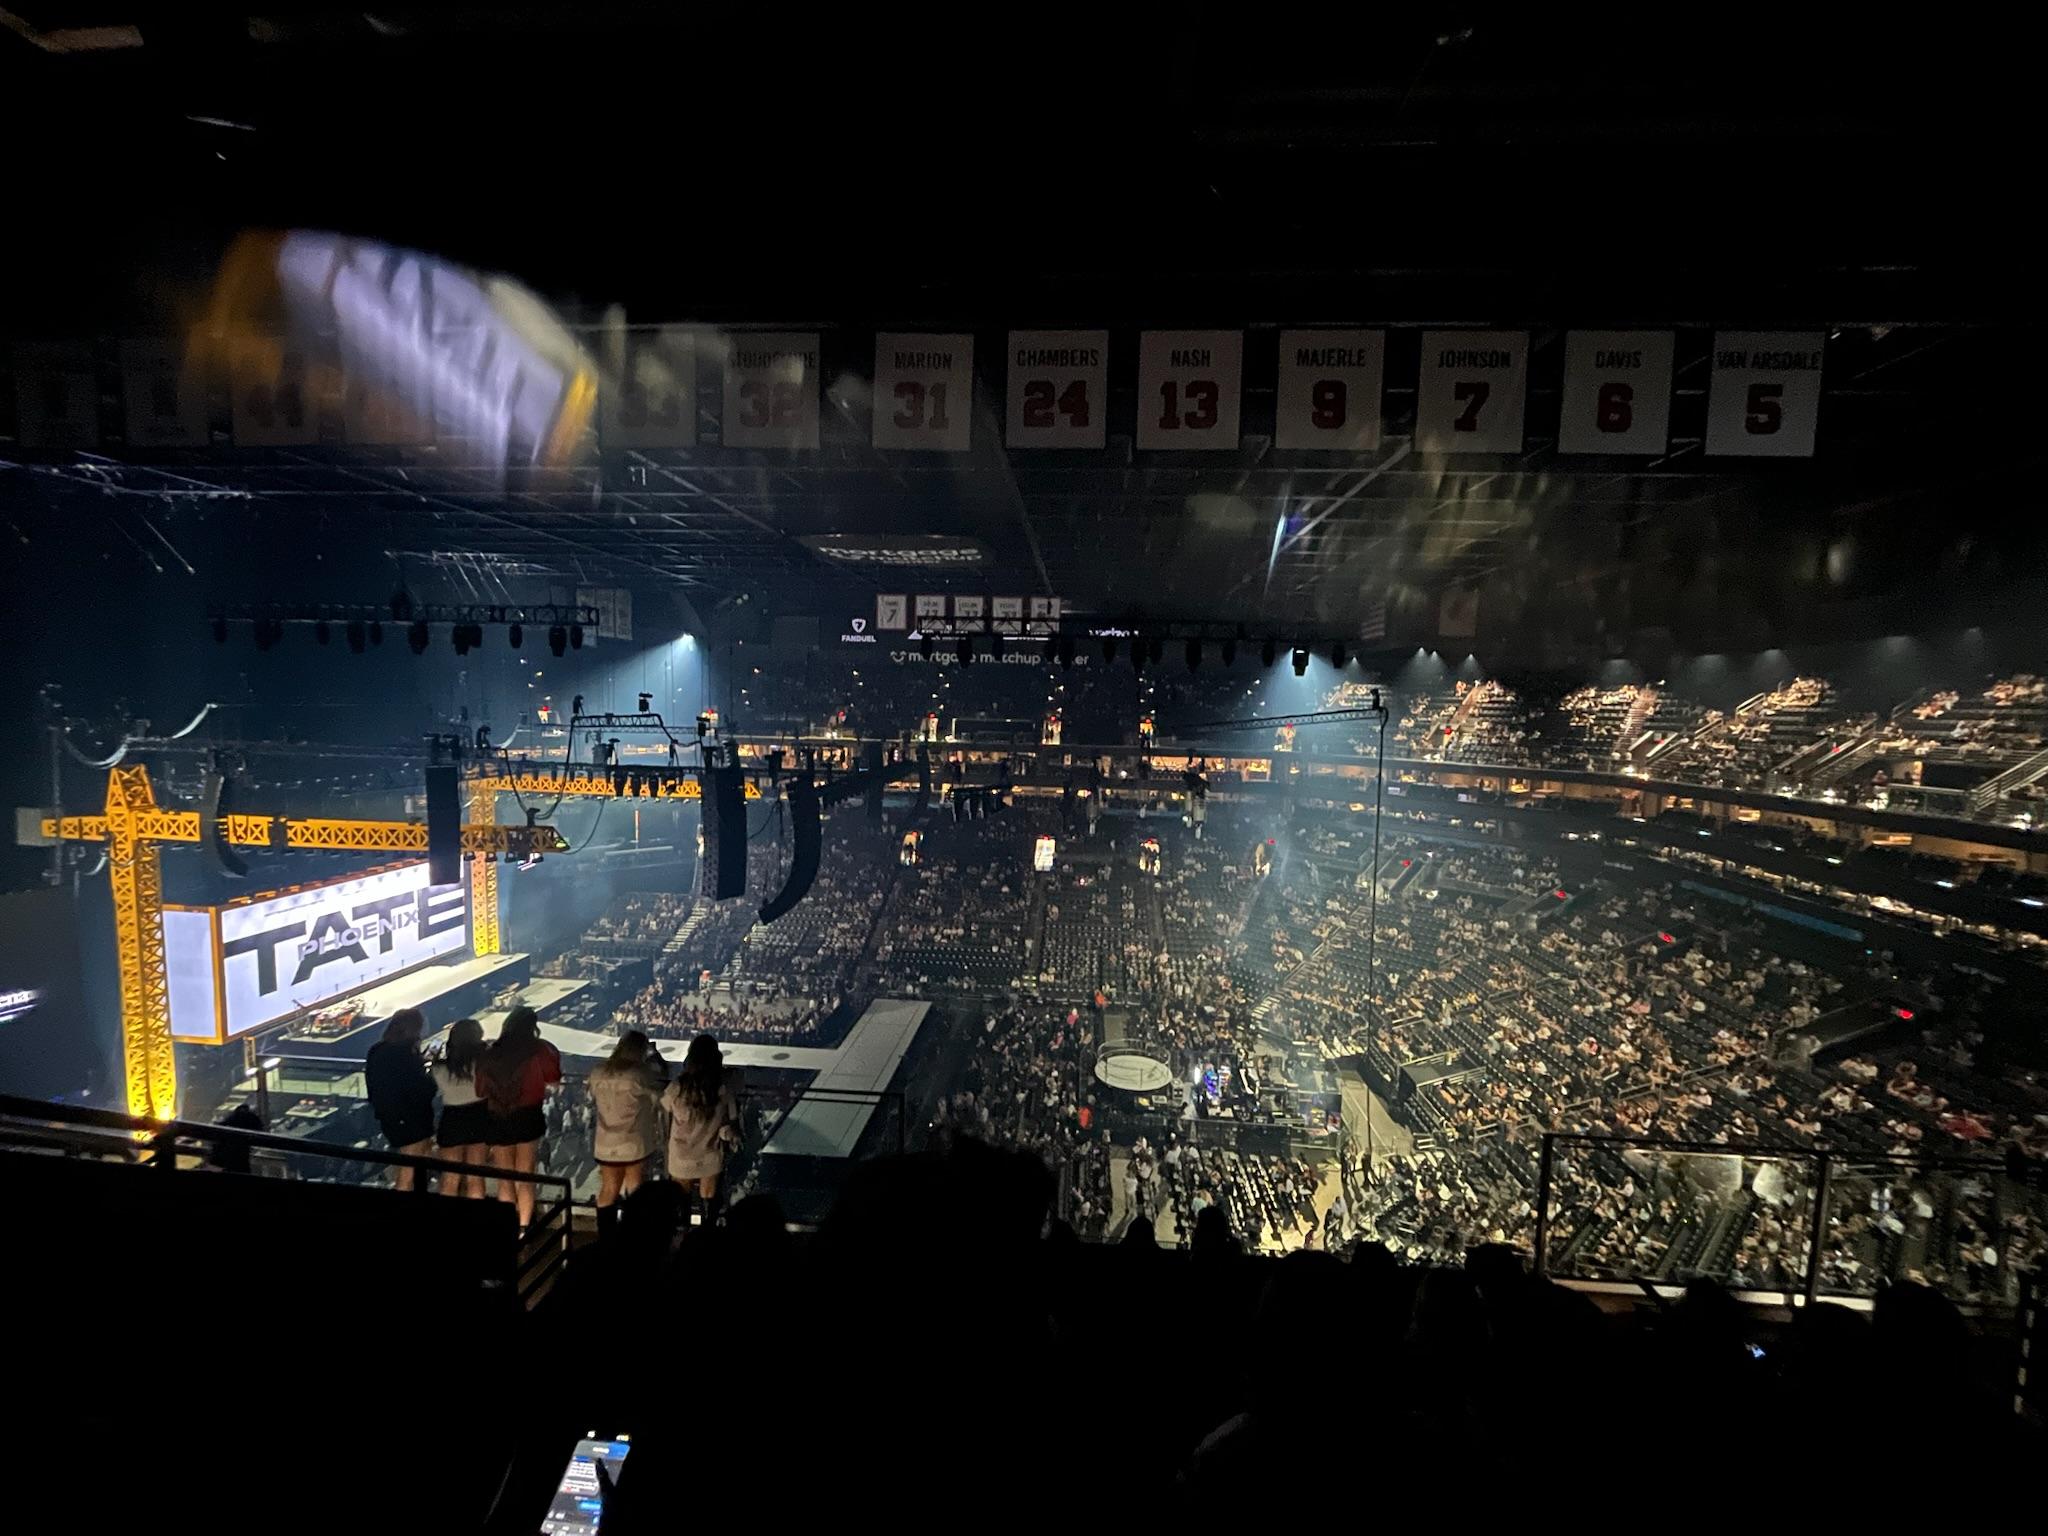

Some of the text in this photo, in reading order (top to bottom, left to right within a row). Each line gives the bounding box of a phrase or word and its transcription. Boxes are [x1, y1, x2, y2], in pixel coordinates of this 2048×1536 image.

[894, 350, 953, 370] MARION
[1017, 348, 1099, 367] CHAMBERS
[1171, 348, 1211, 368] NASH
[1296, 348, 1366, 368] MAJERLE
[1438, 349, 1511, 369] JOHNSON
[1595, 349, 1642, 369] DAVIS
[1716, 350, 1747, 369] VAN
[893, 381, 950, 430] 31
[1023, 380, 1090, 428] 24
[1158, 380, 1219, 430] 13
[1311, 380, 1348, 430] 9
[1454, 382, 1490, 432] 7
[1597, 382, 1635, 433] 6
[1745, 383, 1783, 434] 5
[841, 634, 877, 643] FANDUEL
[908, 651, 976, 666] mrtga
[980, 651, 1041, 666] mtchup
[223, 884, 465, 998] TATE
[297, 908, 421, 961] PHOENIX
